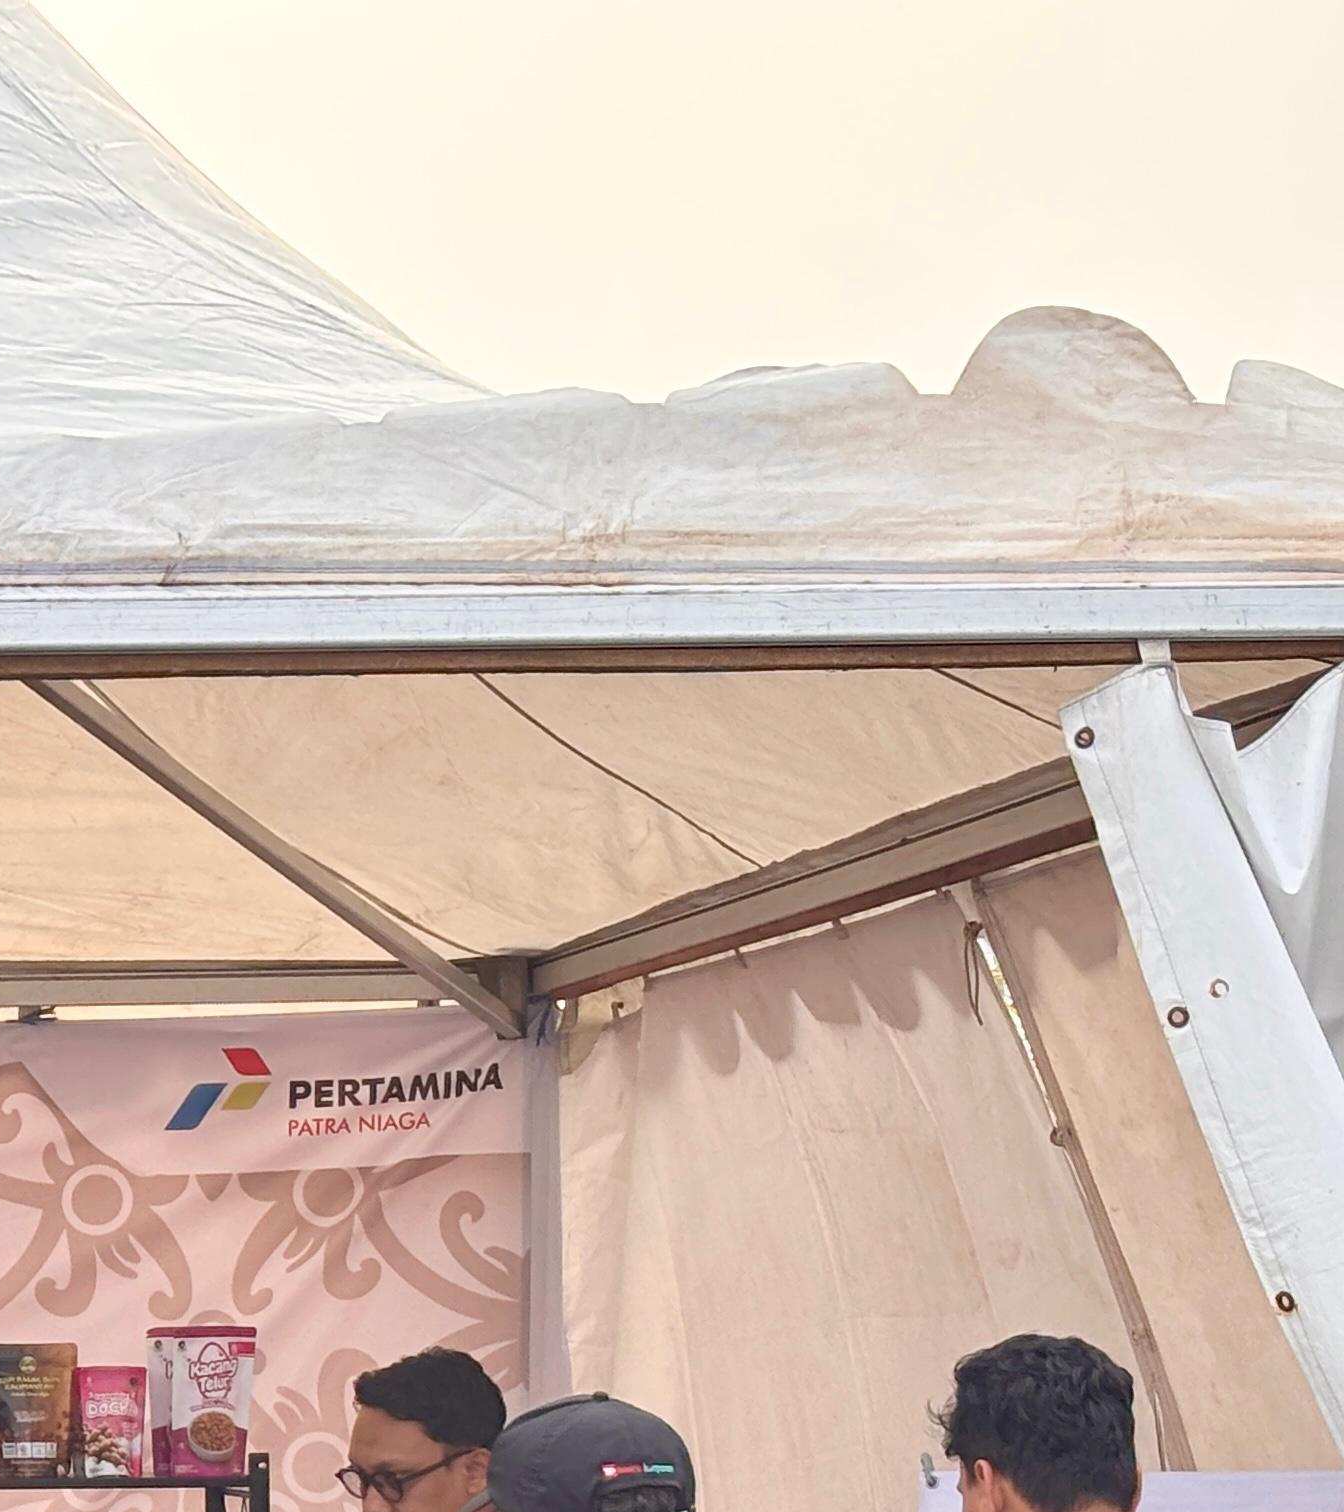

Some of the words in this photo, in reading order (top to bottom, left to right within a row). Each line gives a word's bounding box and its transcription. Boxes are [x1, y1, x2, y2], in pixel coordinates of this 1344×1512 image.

[288, 1063, 504, 1109] PERTAMINA
[288, 1117, 351, 1137] PATRA
[358, 1112, 431, 1134] NIAGA
